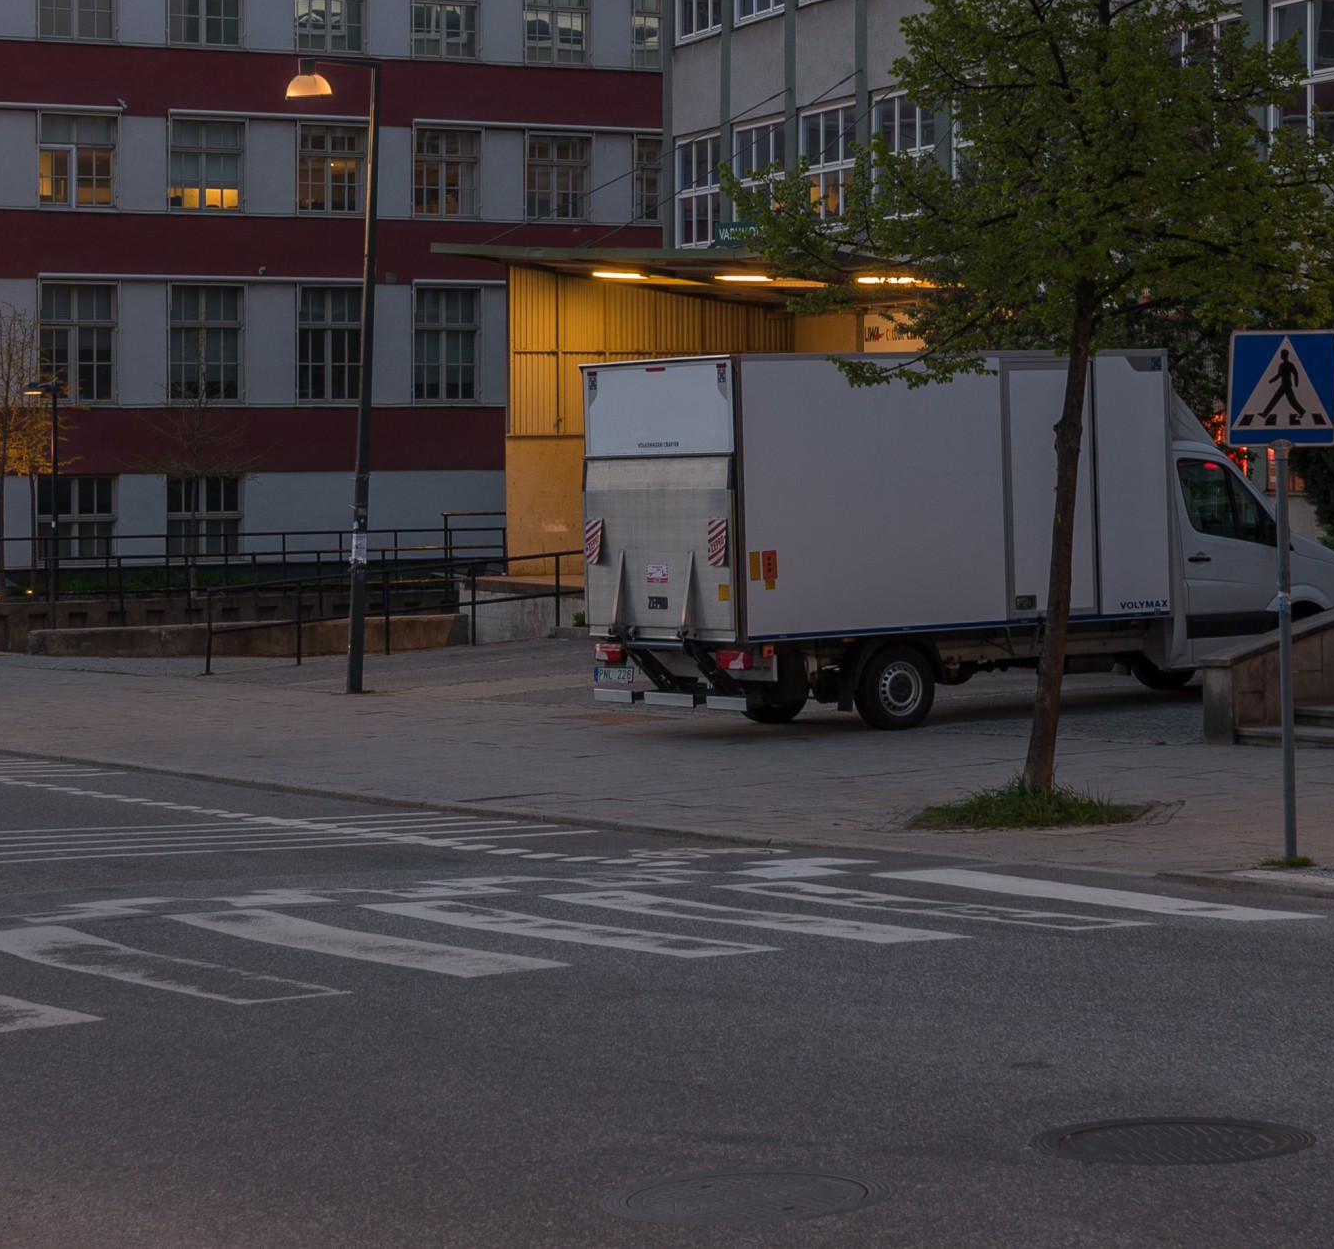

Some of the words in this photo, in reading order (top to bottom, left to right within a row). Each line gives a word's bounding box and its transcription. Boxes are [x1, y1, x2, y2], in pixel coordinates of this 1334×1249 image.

[1120, 599, 1168, 610] VOLYMAX
[599, 668, 613, 680] PNL
[617, 667, 632, 680] 226
